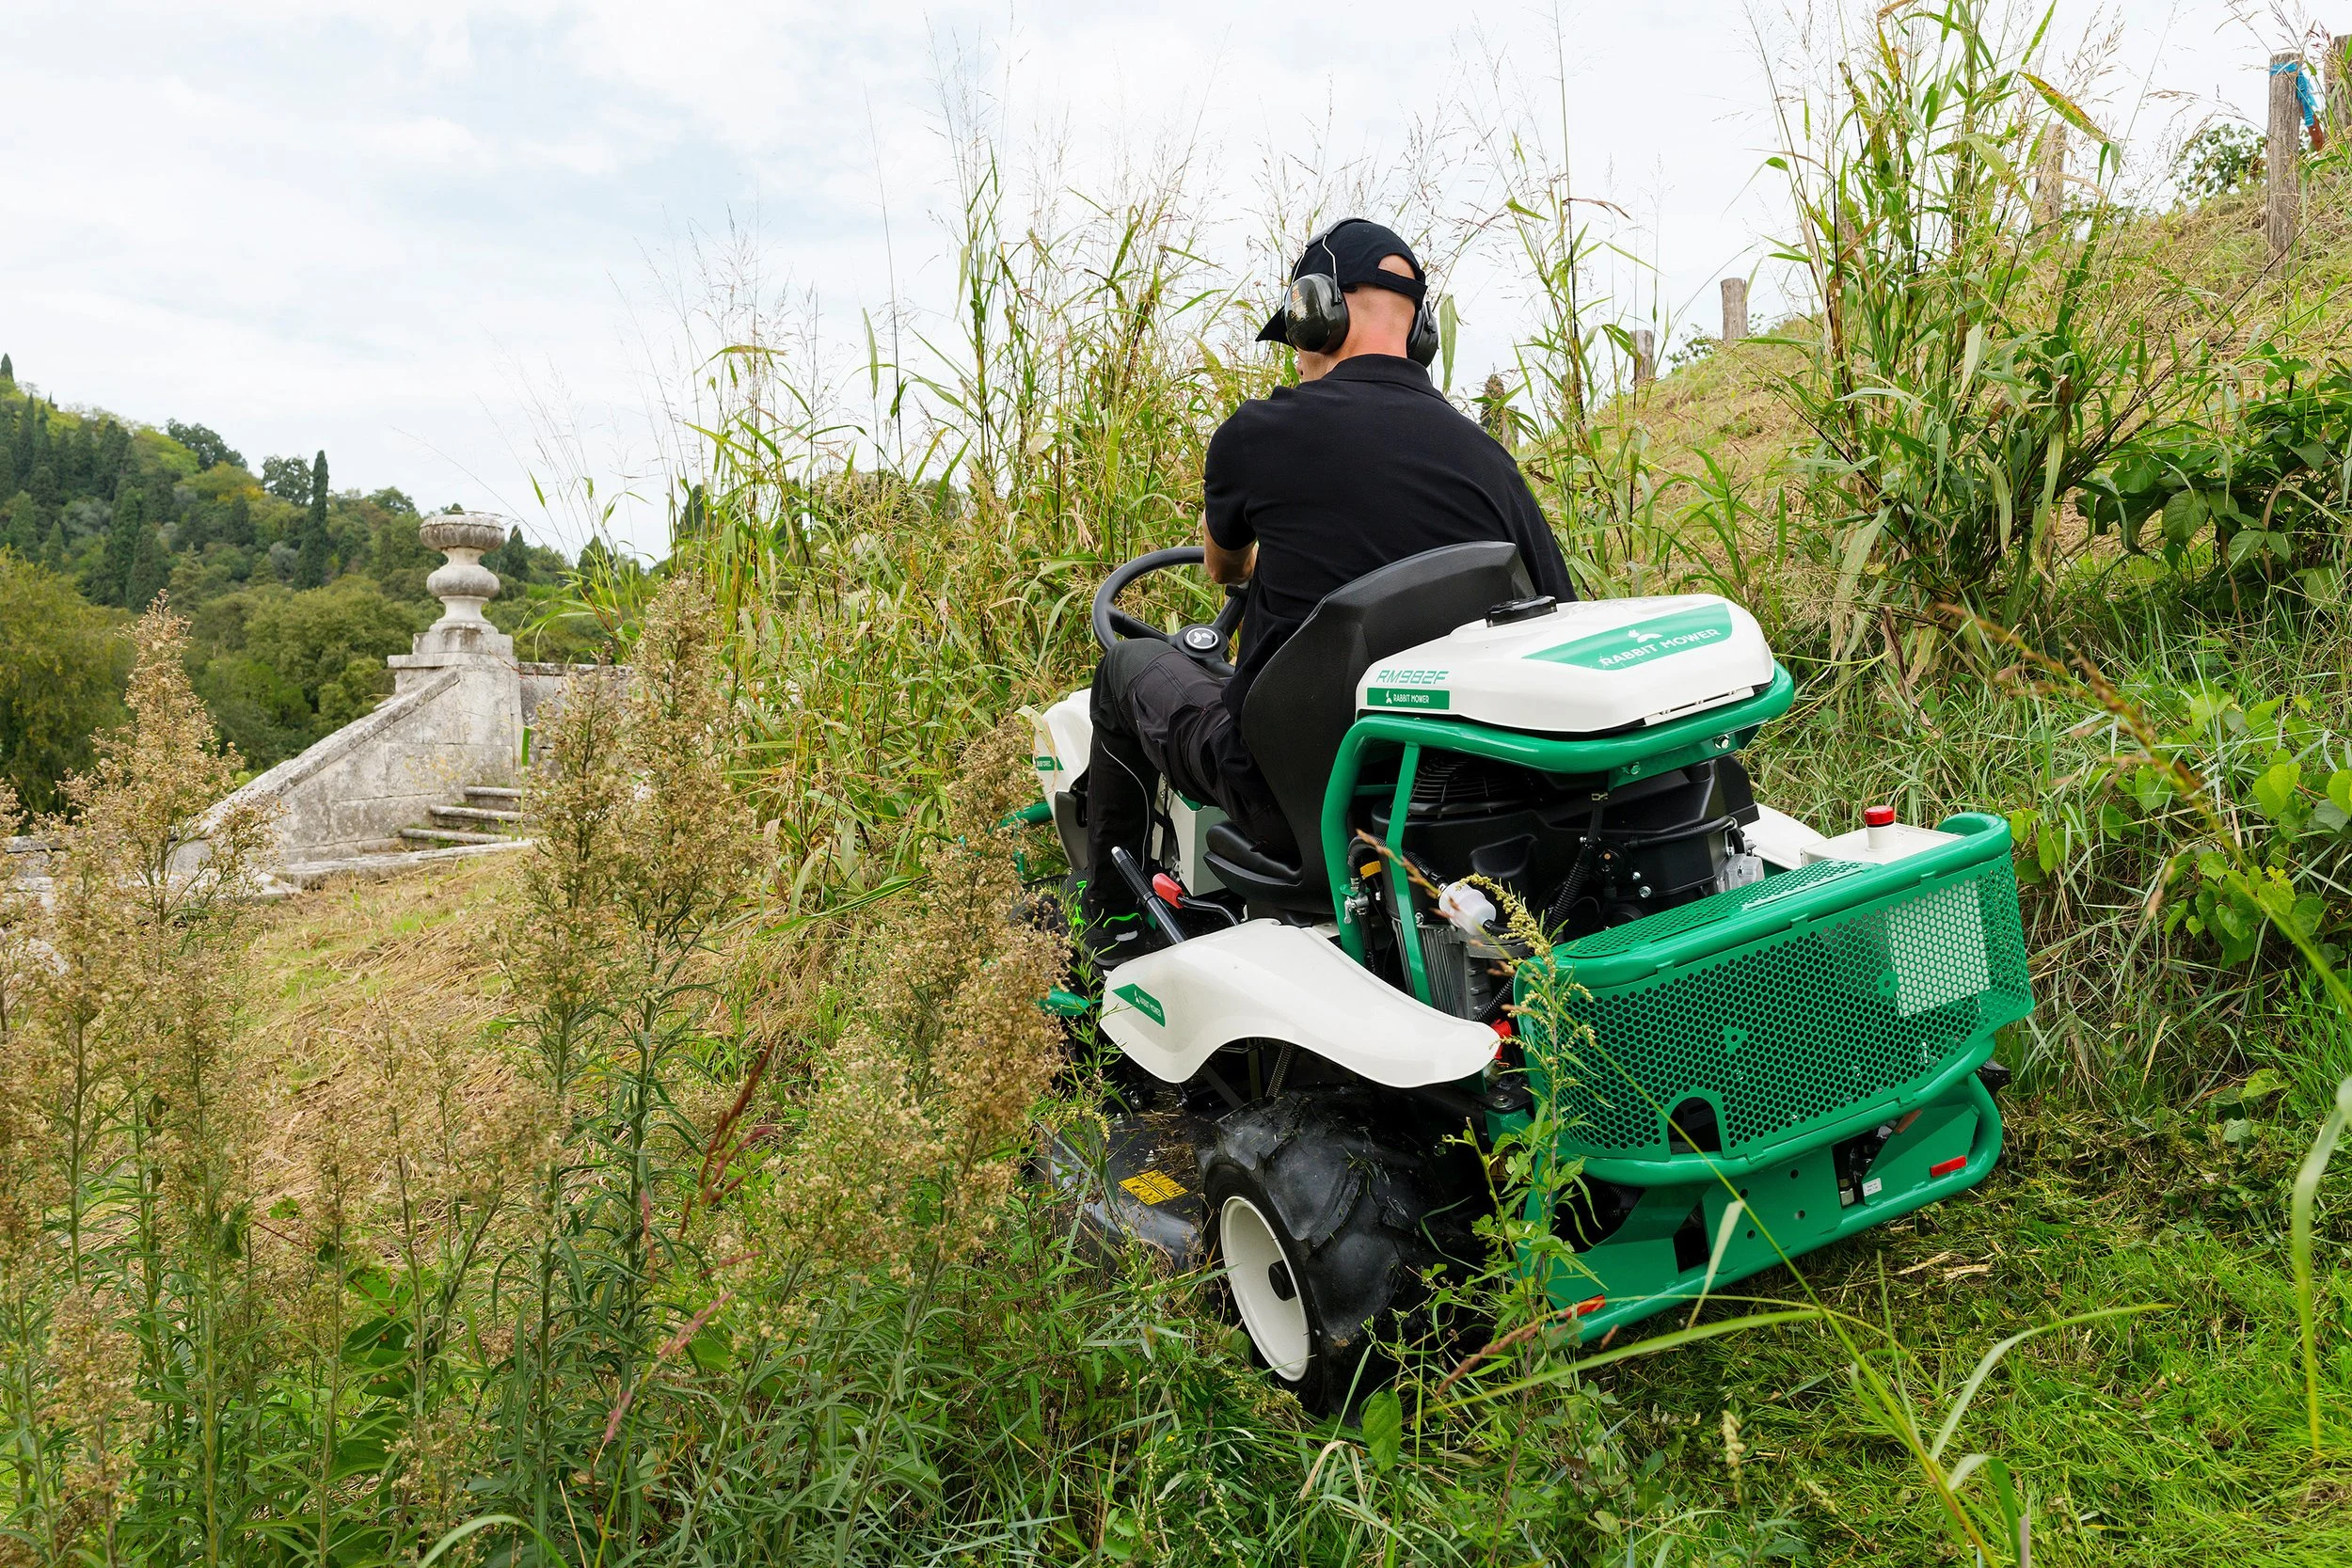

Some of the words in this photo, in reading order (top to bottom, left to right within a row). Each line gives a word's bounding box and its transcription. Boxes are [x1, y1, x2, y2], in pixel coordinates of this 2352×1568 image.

[1598, 643, 1658, 666] RABBIT
[1659, 628, 1721, 649] MOWER
[1376, 670, 1449, 684] RM982F
[1393, 693, 1410, 703] RABBIT
[1411, 695, 1430, 704] MOWER
